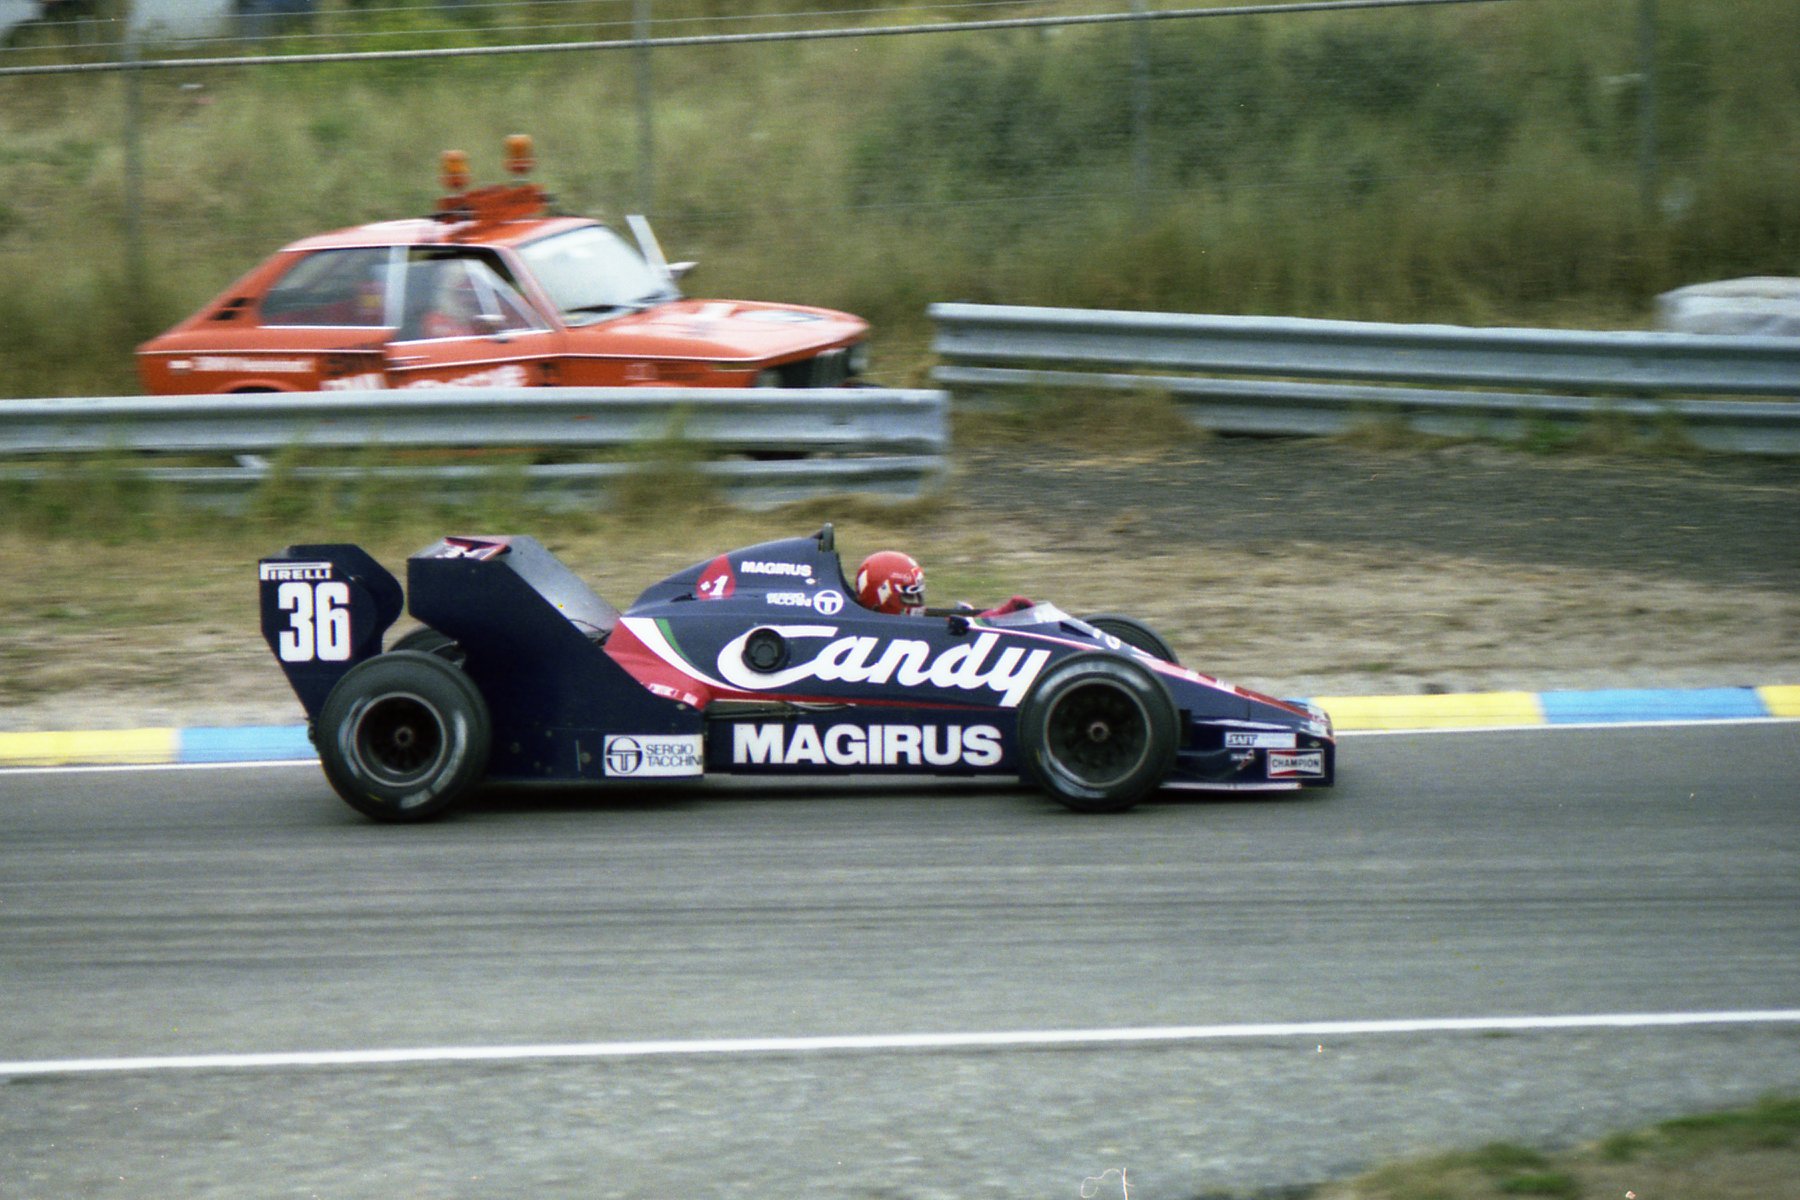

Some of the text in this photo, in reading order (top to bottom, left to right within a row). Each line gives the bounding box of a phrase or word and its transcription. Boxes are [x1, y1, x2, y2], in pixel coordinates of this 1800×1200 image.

[260, 562, 332, 580] PIRELLI
[741, 561, 812, 577] MAGIRUS
[278, 582, 351, 662] 36
[717, 625, 1051, 707] Candy
[646, 744, 694, 755] SERGIO
[733, 723, 1002, 766] MAGIRUS
[1271, 759, 1320, 768] CHAMPION
